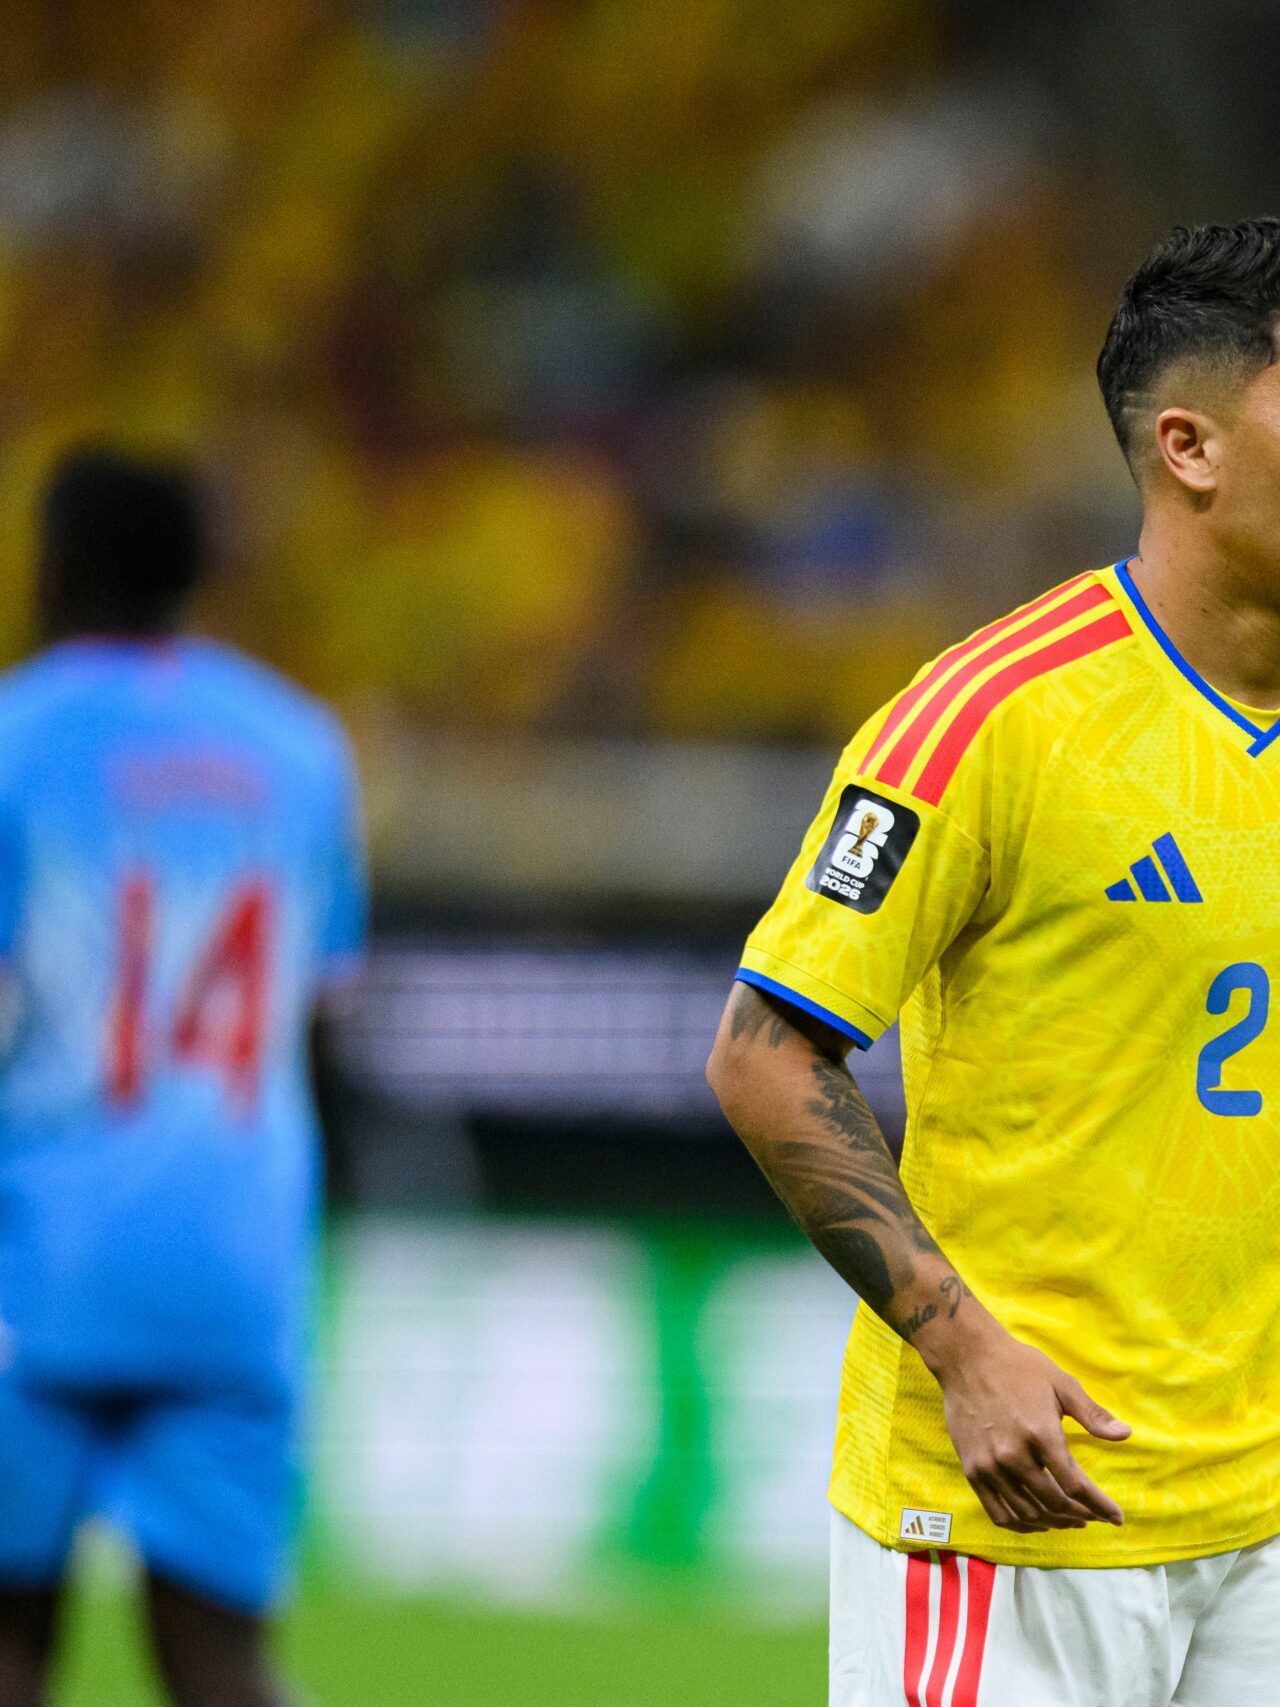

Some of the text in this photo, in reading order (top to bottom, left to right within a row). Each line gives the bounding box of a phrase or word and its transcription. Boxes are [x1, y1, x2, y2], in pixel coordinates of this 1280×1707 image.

[841, 855, 862, 870] FIFA
[819, 875, 862, 901] 2026
[825, 866, 866, 890] WORLD CUP
